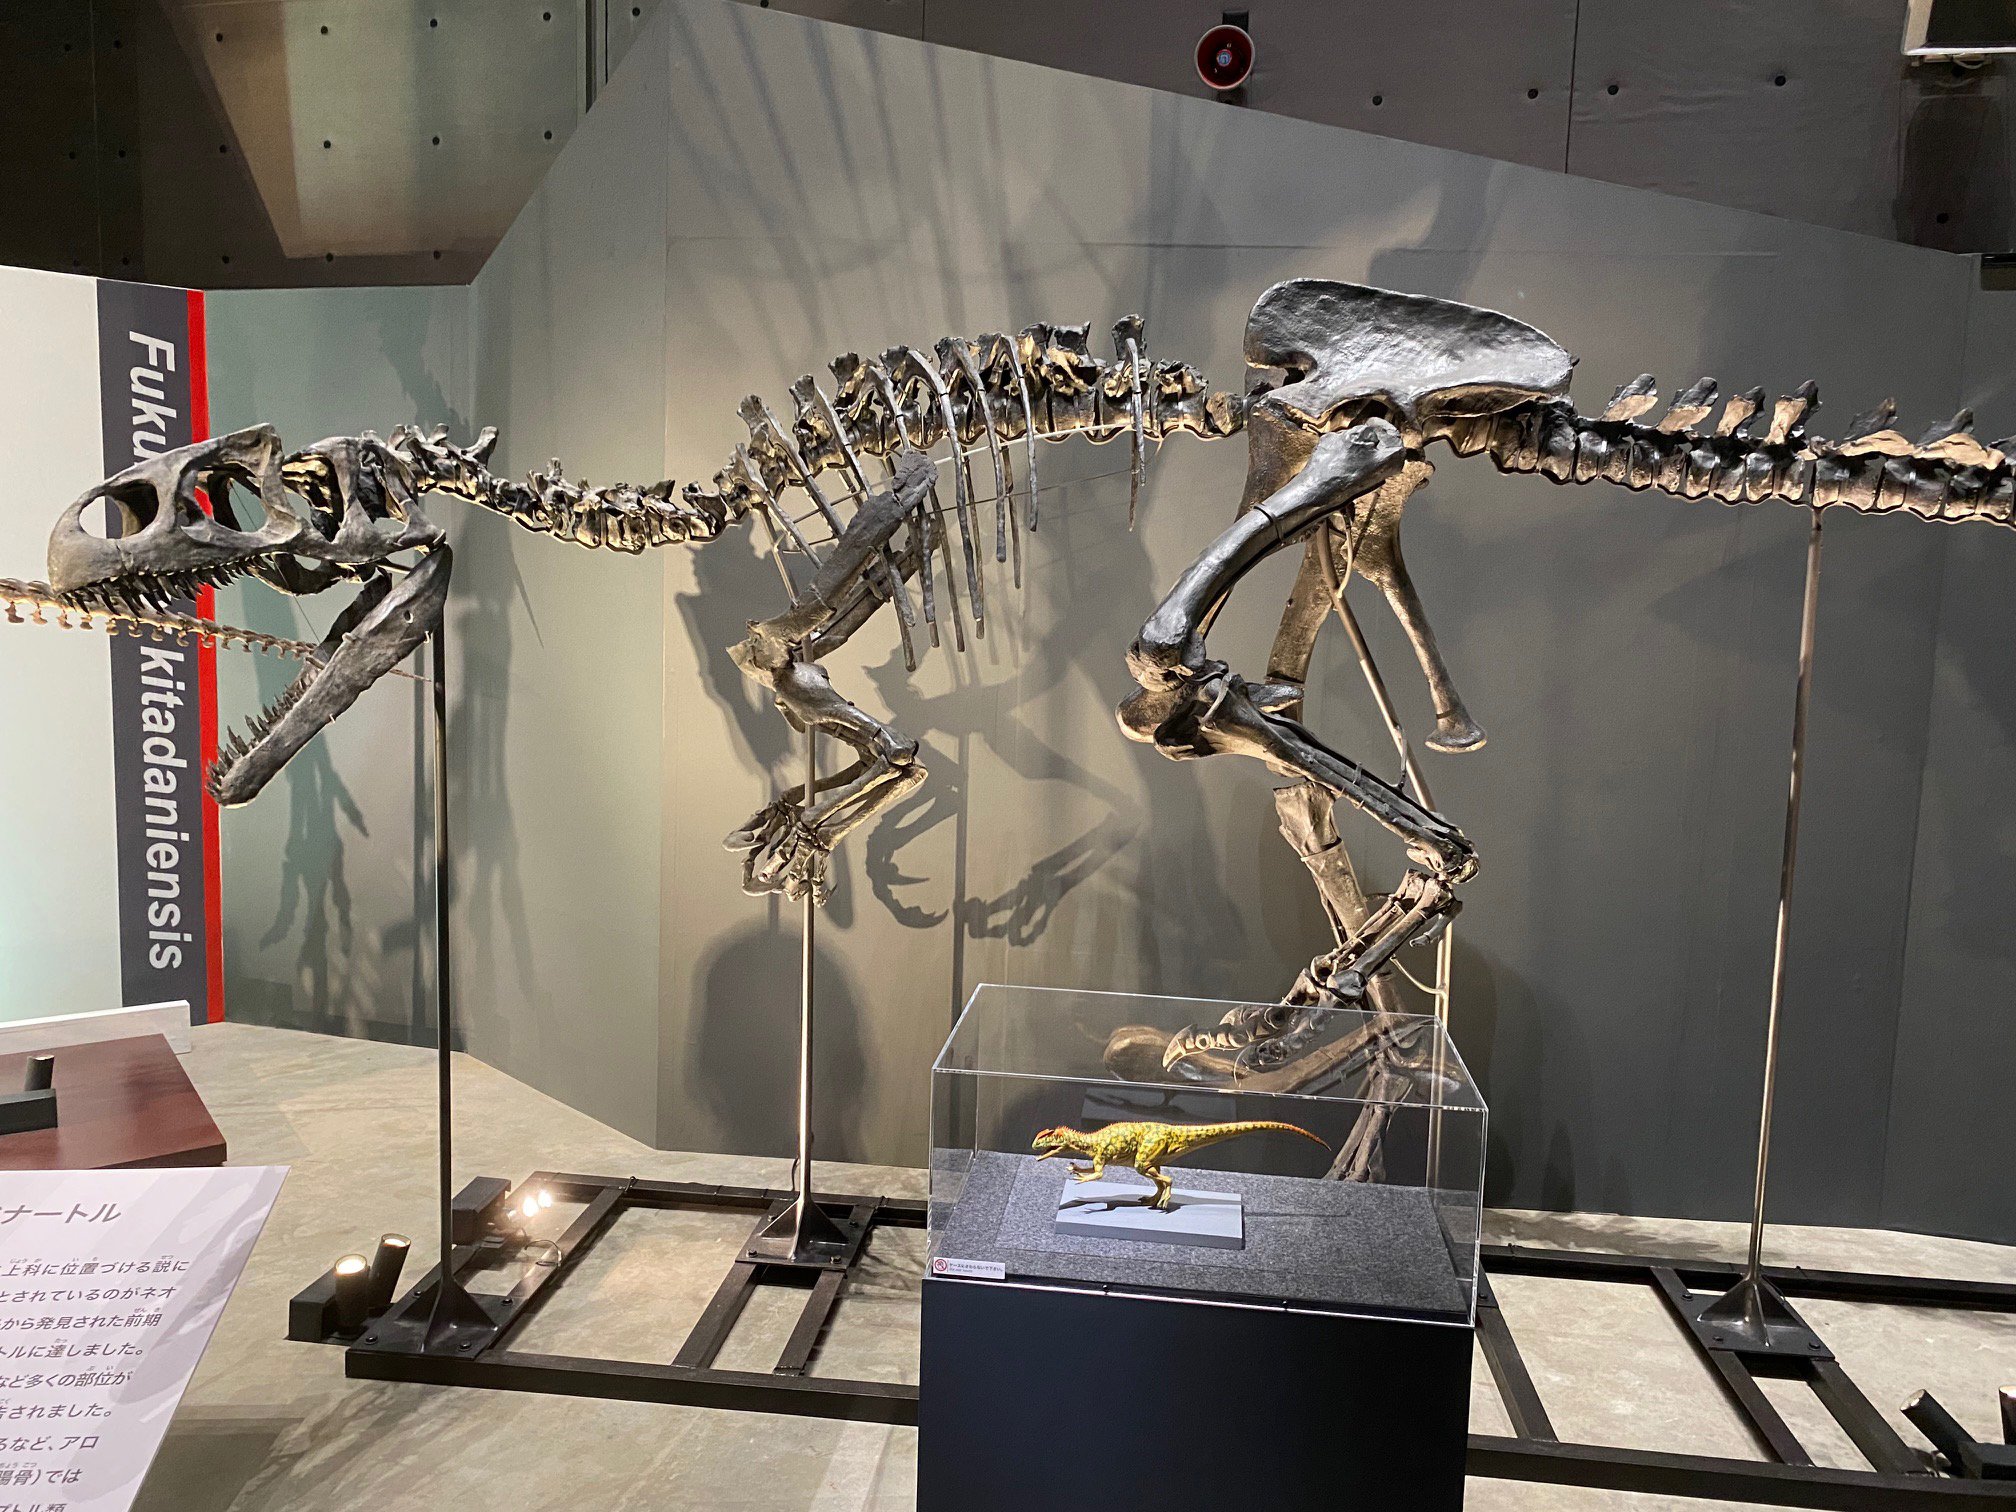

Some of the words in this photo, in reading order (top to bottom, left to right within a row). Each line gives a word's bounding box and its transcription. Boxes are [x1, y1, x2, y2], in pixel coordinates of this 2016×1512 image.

[129, 331, 177, 462] Fuku
[140, 645, 192, 970] kitadaniensis
[0, 1203, 122, 1224] ナートル
[0, 1260, 190, 1277] 上科に位置づける説に
[0, 1313, 162, 1330] から発見された前期
